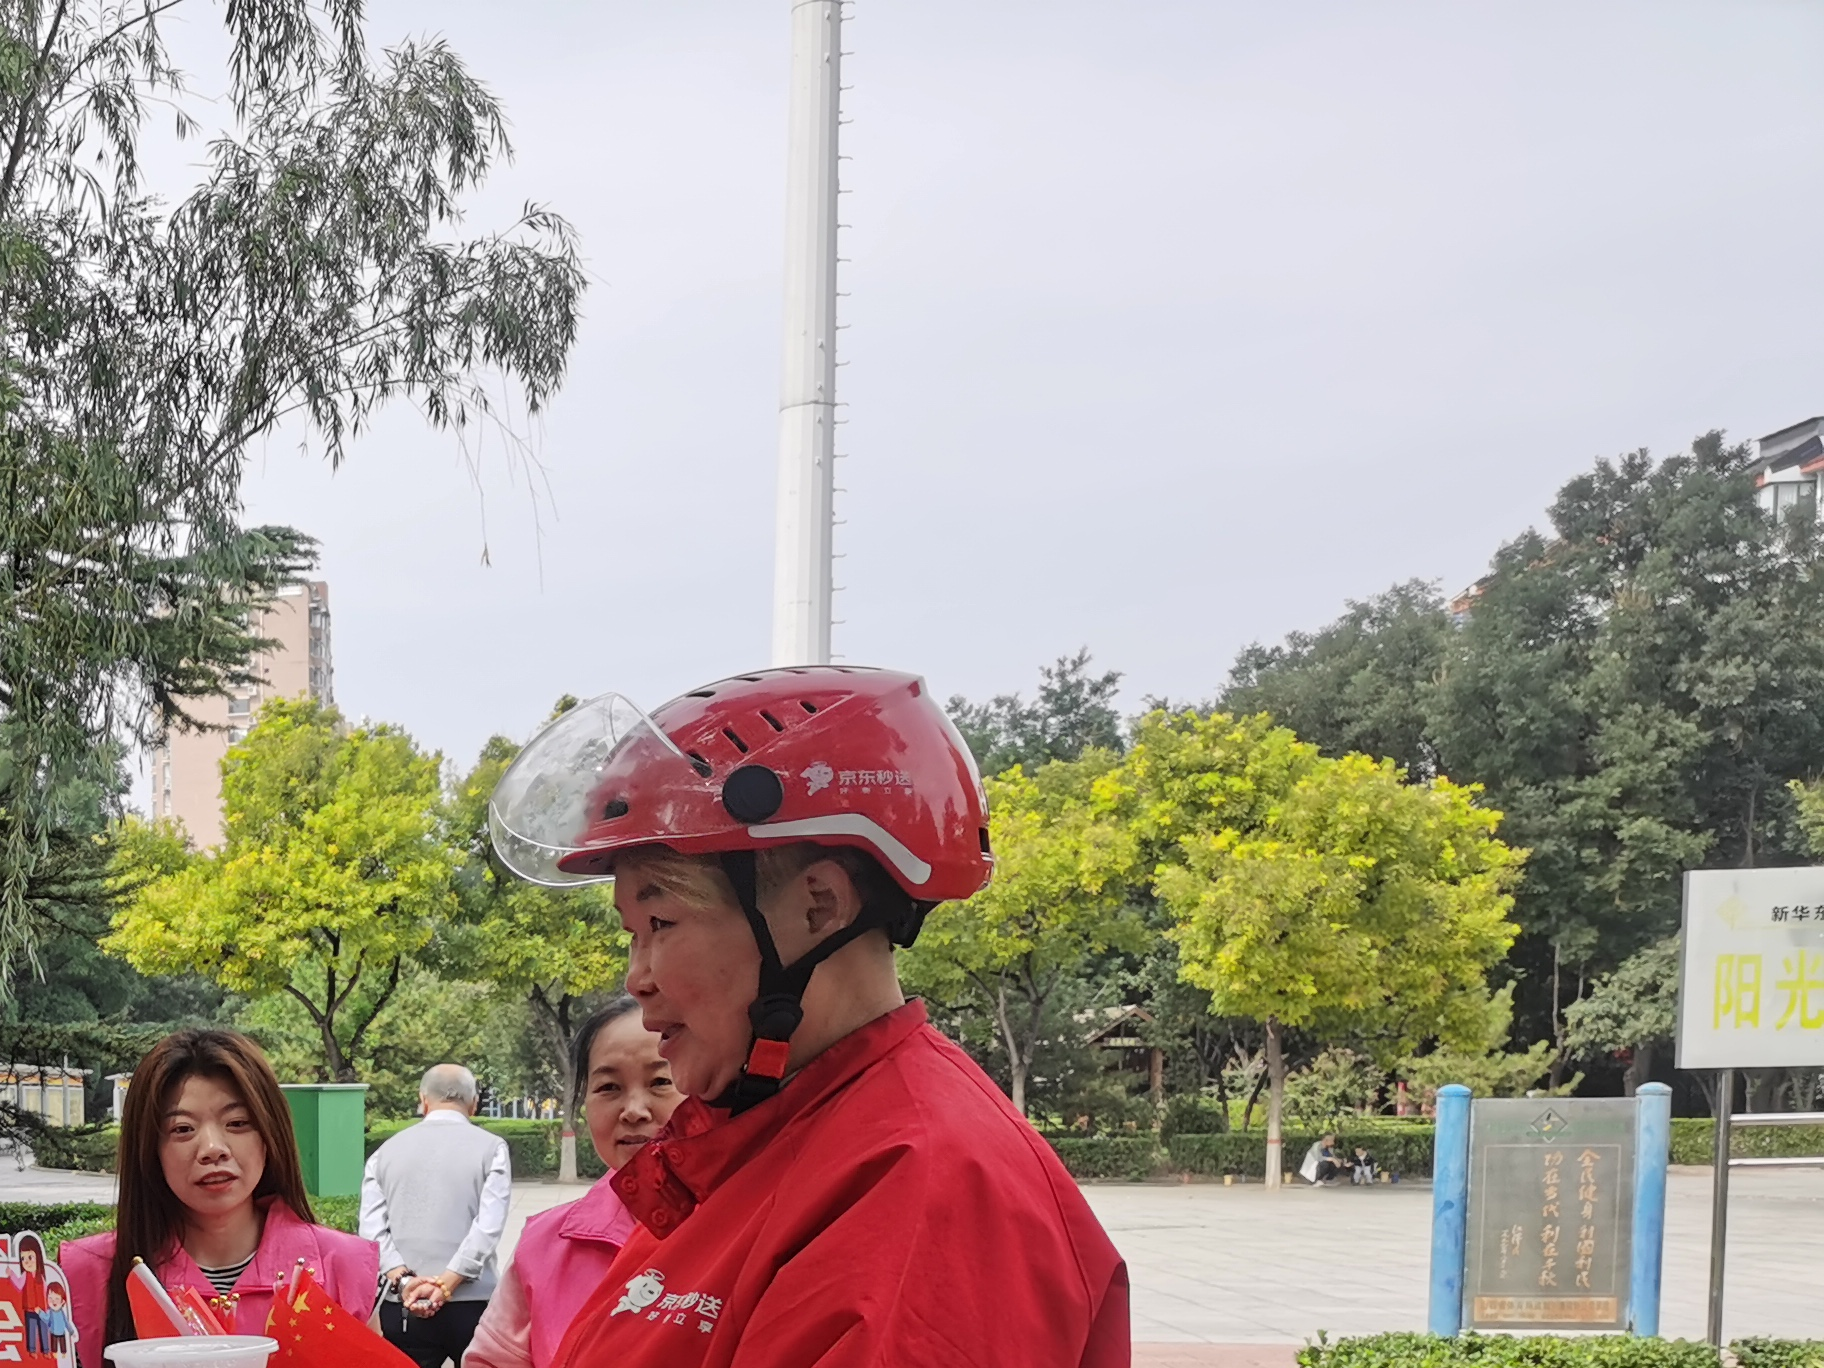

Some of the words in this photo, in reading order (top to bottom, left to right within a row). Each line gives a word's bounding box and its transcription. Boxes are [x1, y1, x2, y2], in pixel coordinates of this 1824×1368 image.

[838, 769, 914, 786] 京东秒送
[1713, 948, 1824, 1031] 阳光
